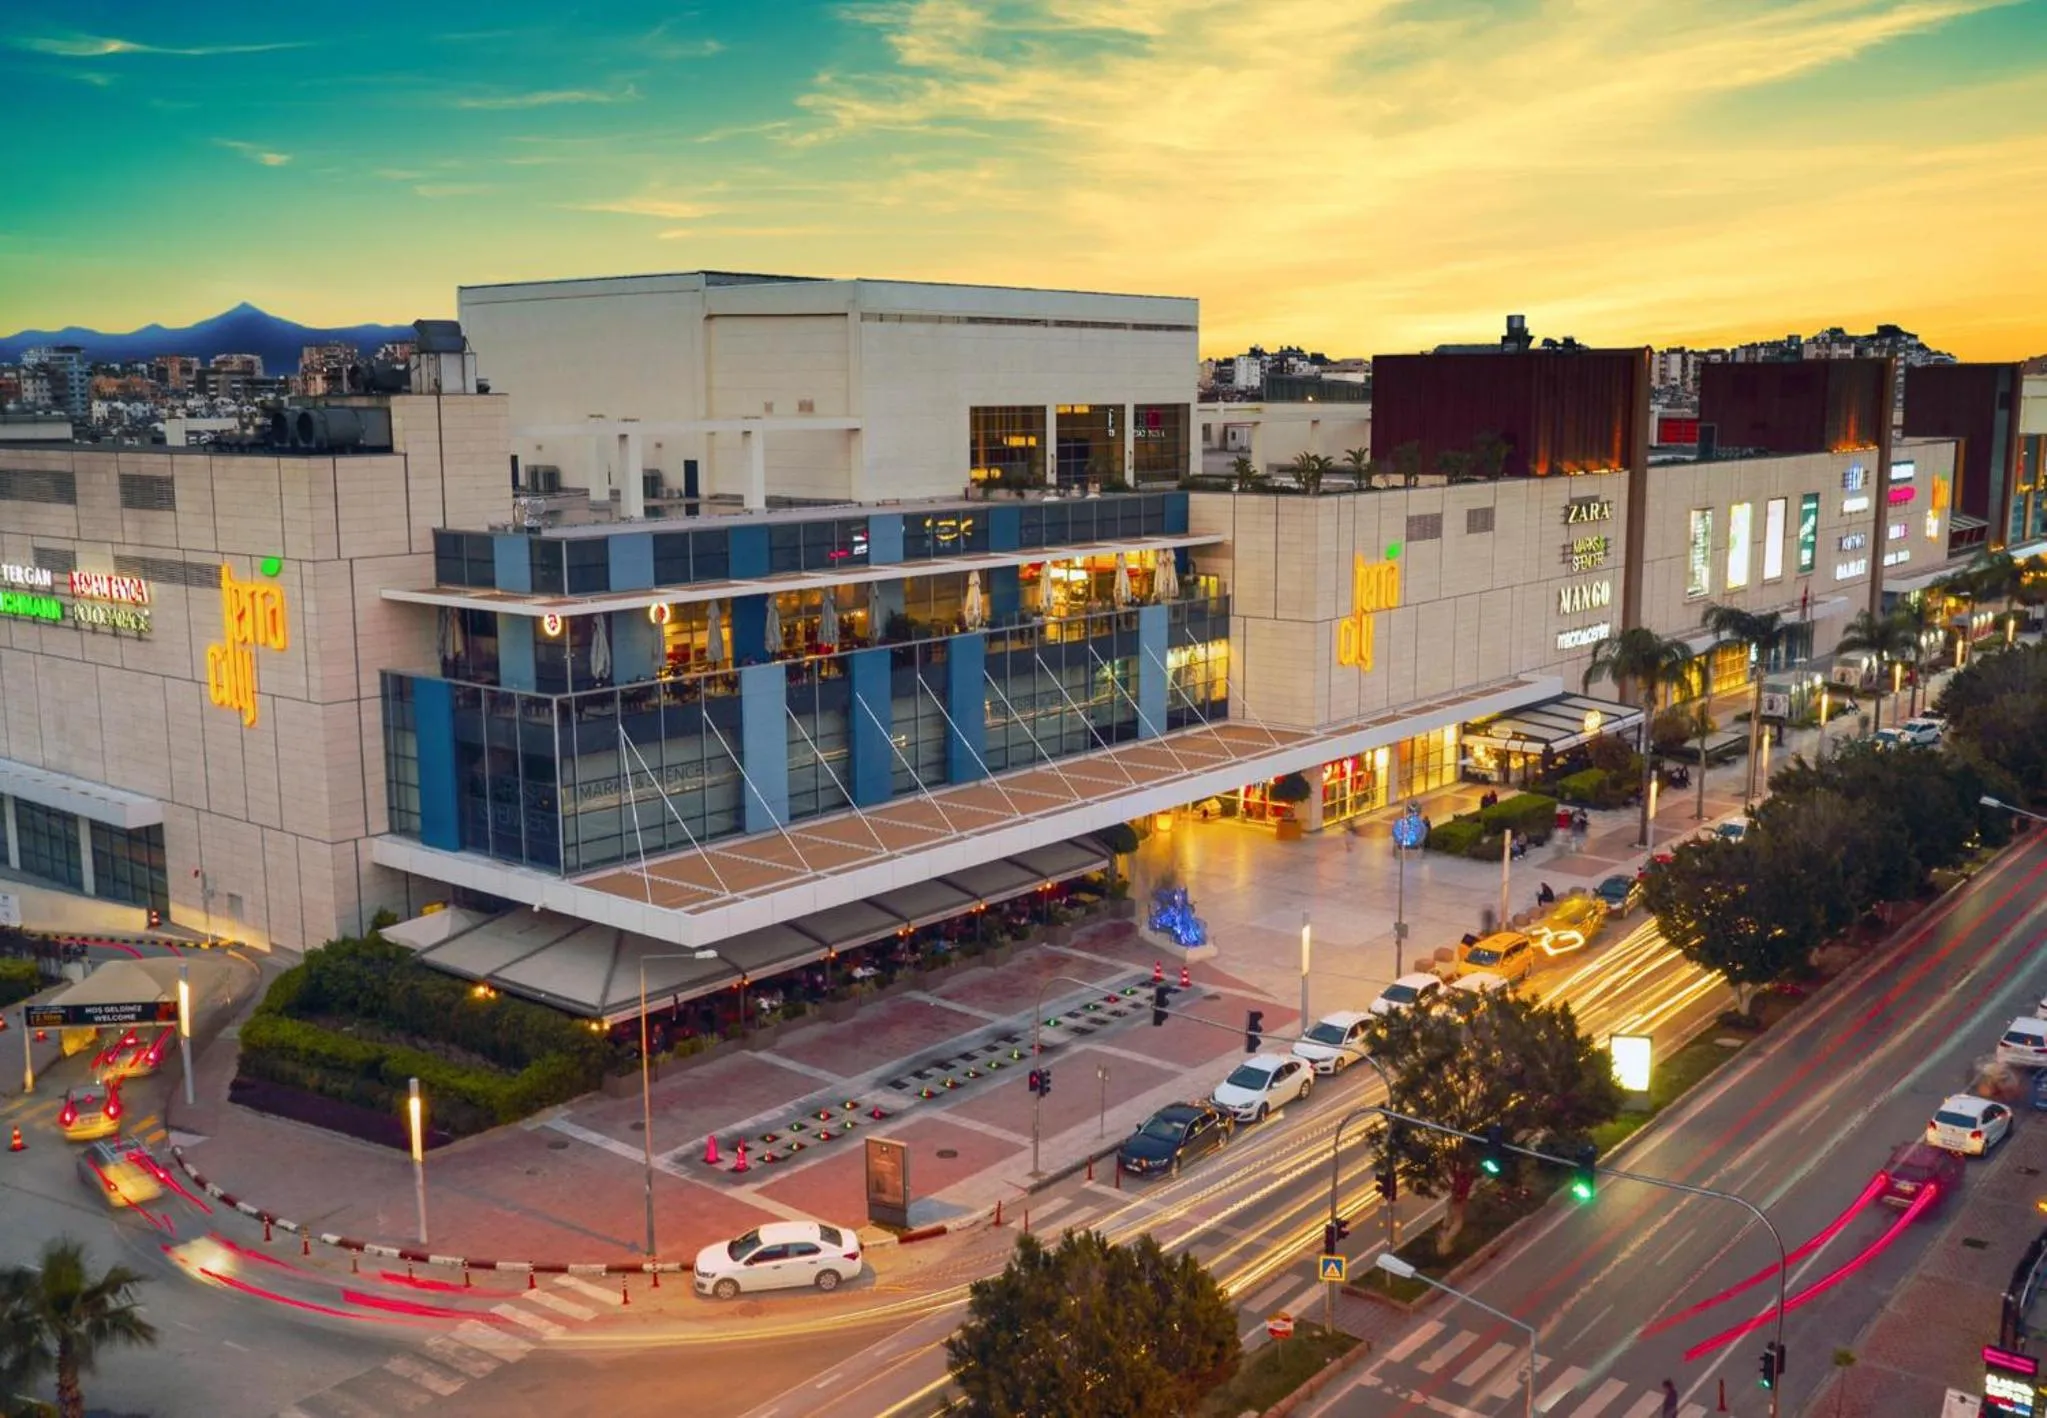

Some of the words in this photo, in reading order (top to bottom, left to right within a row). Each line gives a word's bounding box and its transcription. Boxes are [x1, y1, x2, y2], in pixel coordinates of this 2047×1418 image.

[1568, 502, 1610, 524] ZARA
[2, 564, 52, 586] TERGAN
[1560, 579, 1611, 615] MANGO
[93, 1013, 136, 1022] WELCOME
